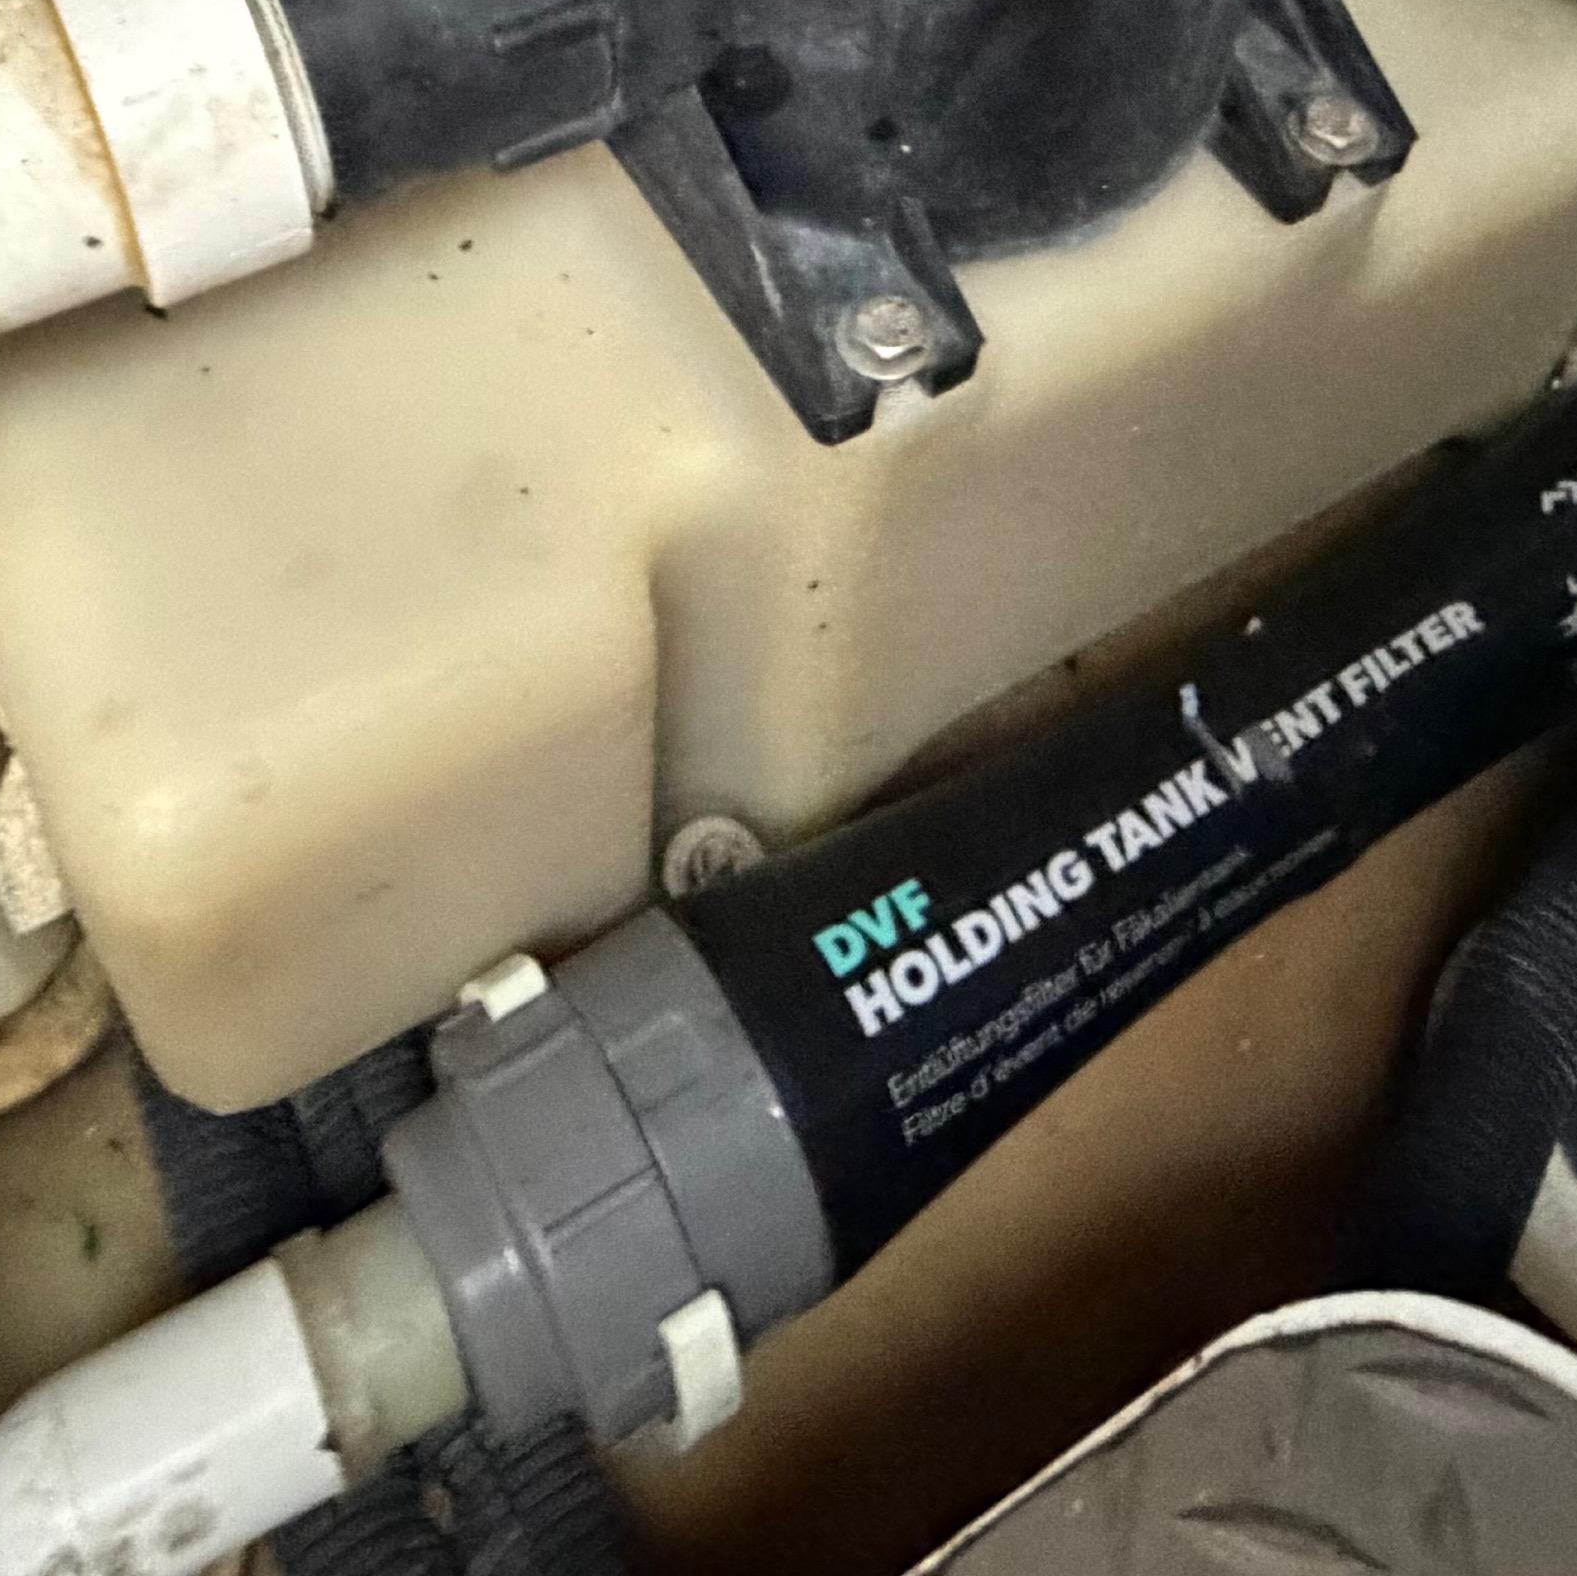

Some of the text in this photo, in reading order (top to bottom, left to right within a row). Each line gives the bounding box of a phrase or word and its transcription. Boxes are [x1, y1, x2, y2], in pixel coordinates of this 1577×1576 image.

[812, 877, 931, 978] DVF
[843, 849, 1096, 1038] HOLDING
[1082, 759, 1228, 874] TANK
[1337, 598, 1487, 708] FILTER
